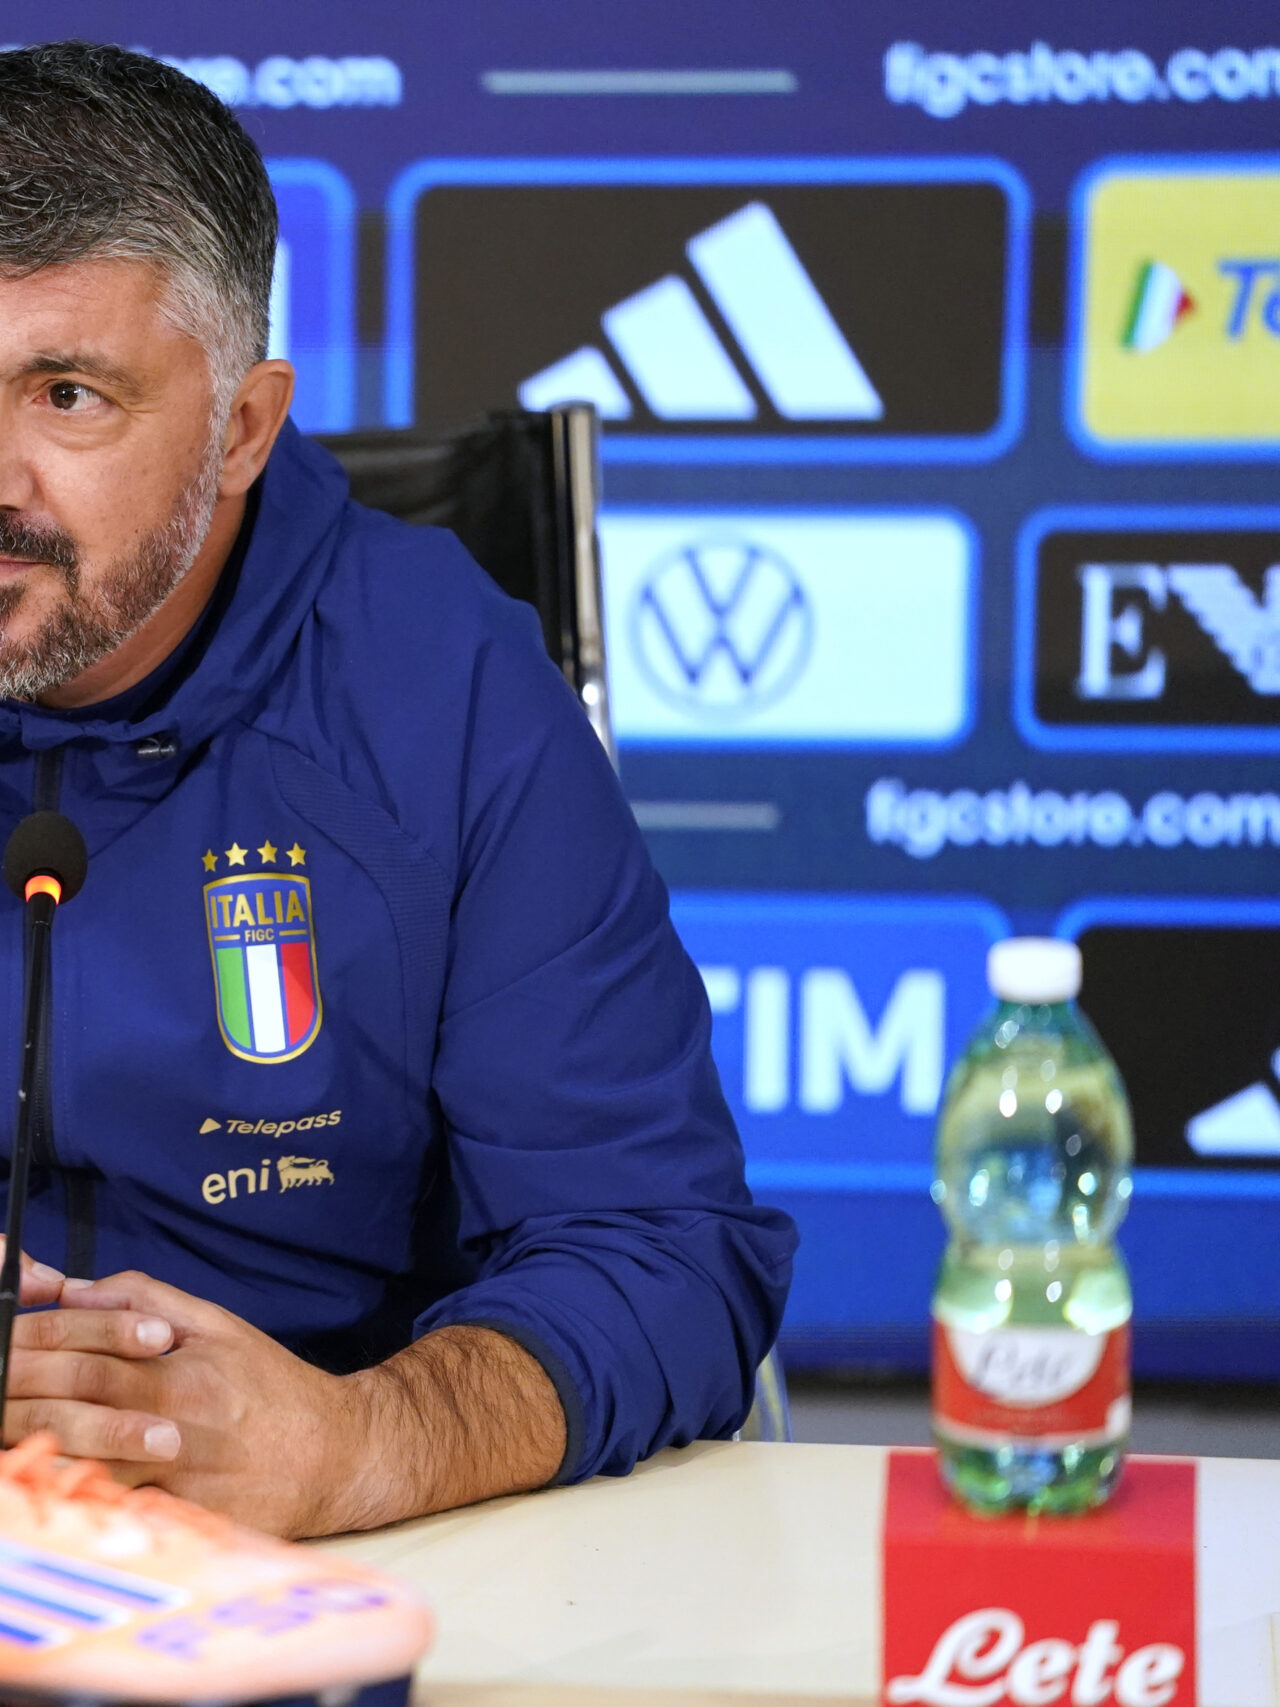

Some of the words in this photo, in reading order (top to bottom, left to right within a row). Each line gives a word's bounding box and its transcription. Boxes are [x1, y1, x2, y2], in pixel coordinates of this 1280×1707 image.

[210, 890, 305, 928] ITALIA
[244, 928, 275, 943] FIGC
[226, 1110, 342, 1138] Telepass
[202, 1158, 271, 1205] eni
[887, 1607, 1185, 1706] Lete
